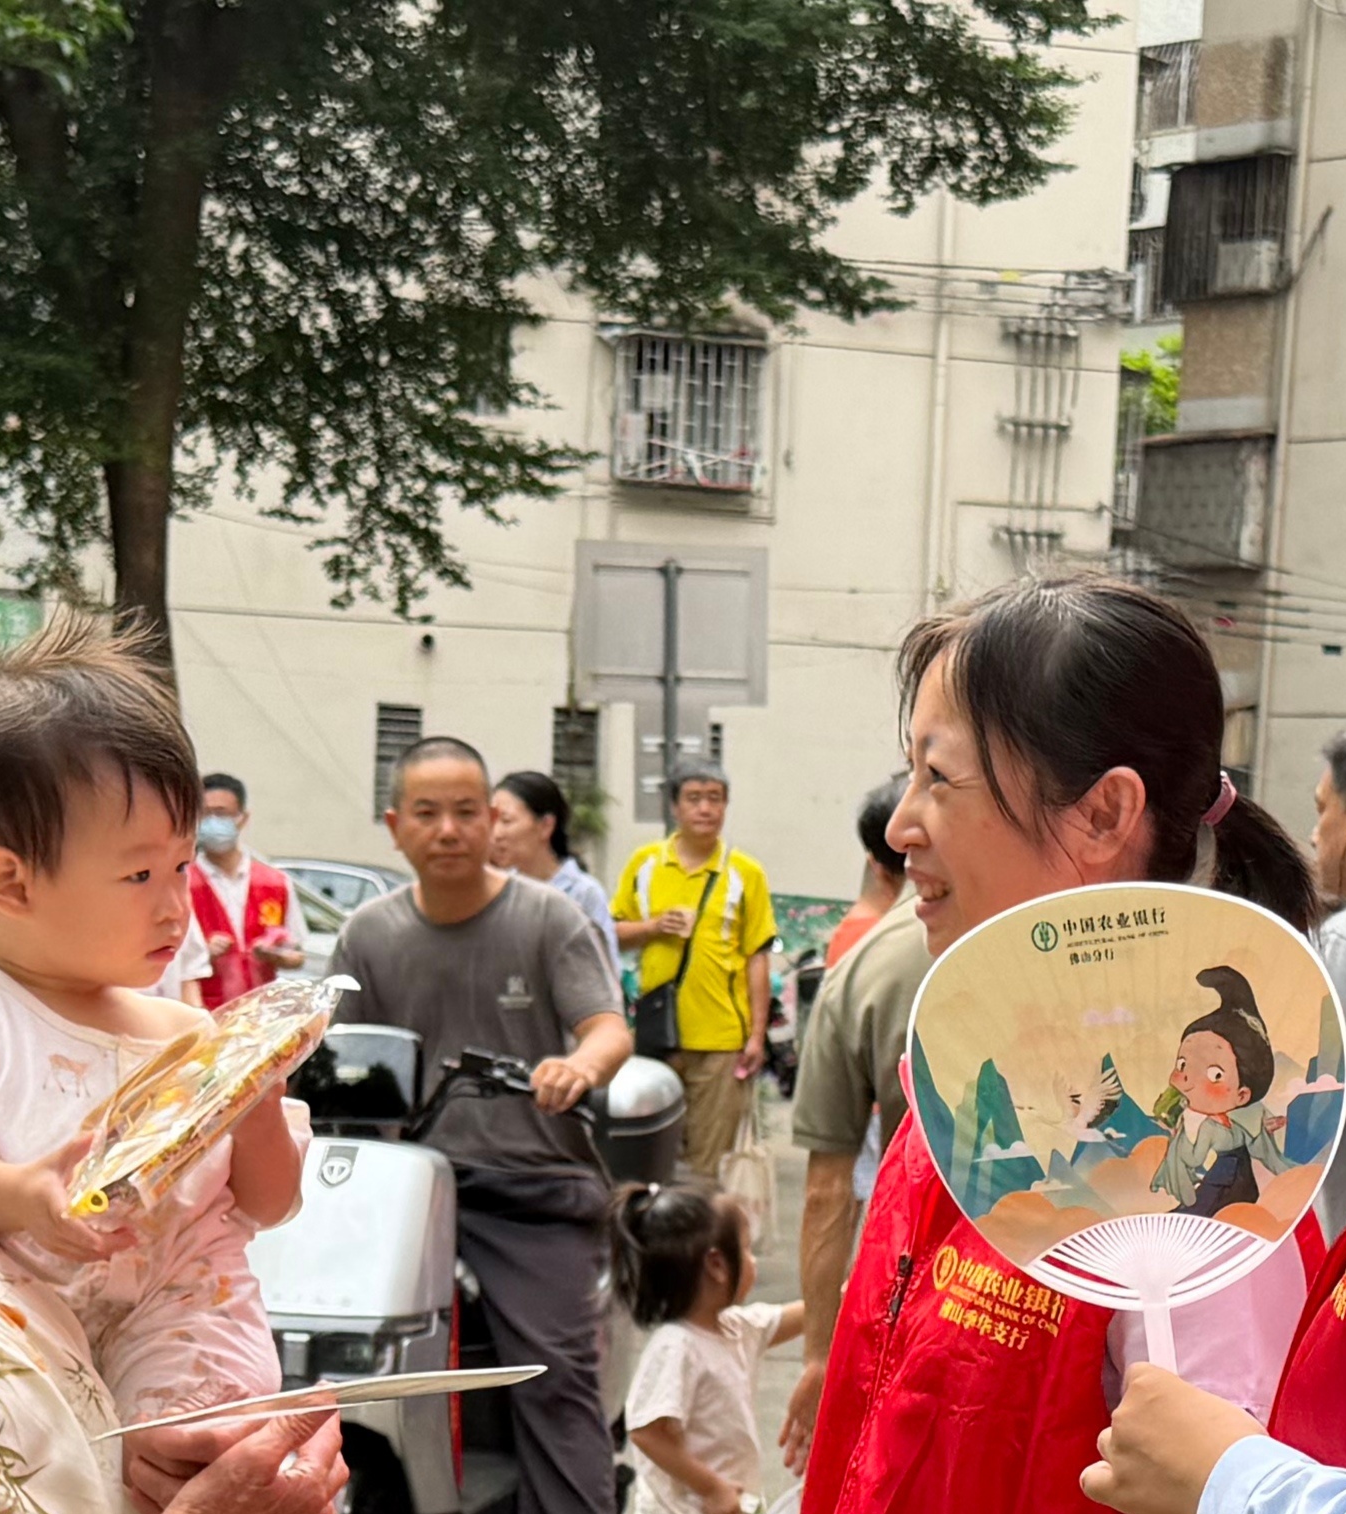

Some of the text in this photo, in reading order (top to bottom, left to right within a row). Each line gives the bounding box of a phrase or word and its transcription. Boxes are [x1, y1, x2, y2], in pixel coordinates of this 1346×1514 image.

[1063, 907, 1166, 936] 中国农业银行
[1069, 948, 1114, 966] 佛山分行
[957, 1257, 1067, 1326] 中国农业银行
